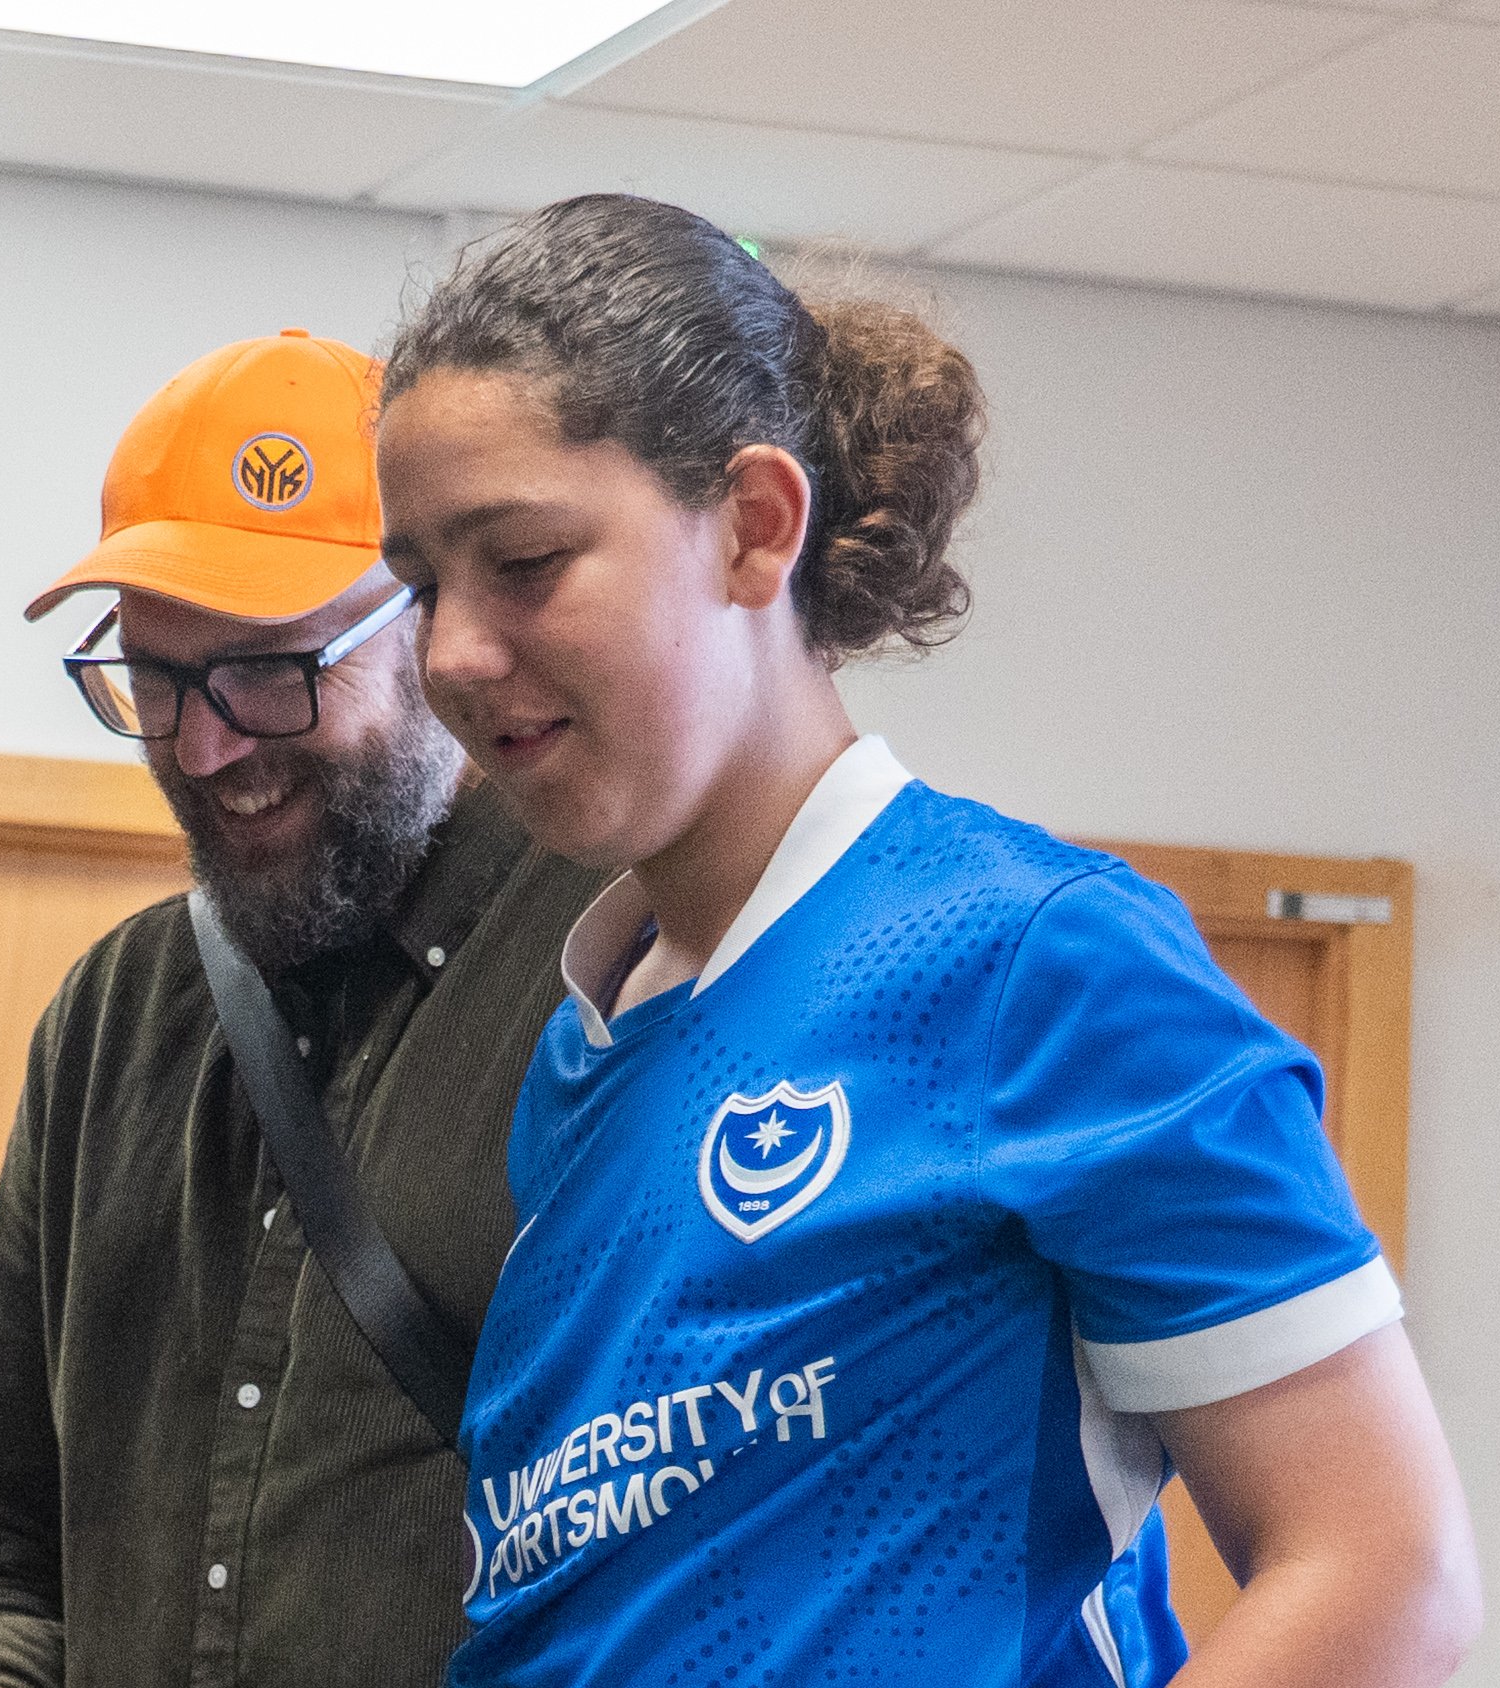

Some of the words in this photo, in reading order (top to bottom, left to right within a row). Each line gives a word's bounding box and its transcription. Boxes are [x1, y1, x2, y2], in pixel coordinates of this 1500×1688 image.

[241, 446, 304, 503] NYK
[738, 1200, 770, 1212] 1898
[482, 1369, 763, 1531] UNIVERSITY
